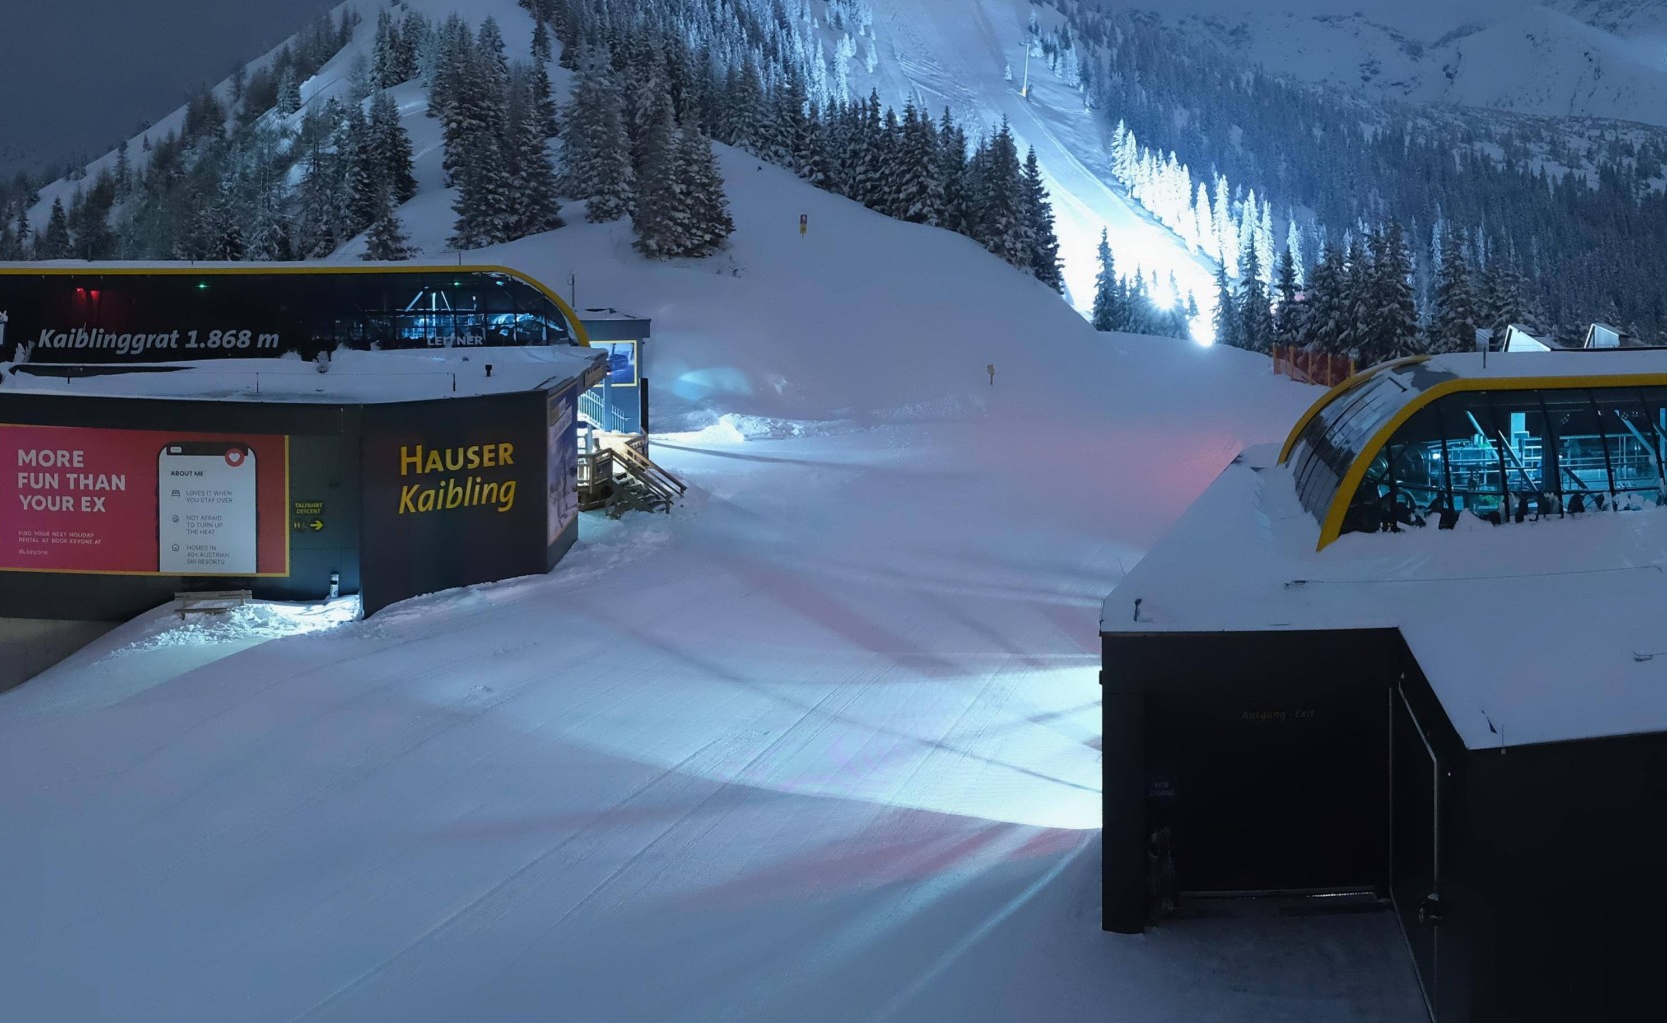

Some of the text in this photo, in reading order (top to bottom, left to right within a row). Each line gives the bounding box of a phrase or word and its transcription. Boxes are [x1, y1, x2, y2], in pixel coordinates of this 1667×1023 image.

[38, 328, 280, 355] Kaiblinggrat 1.868 m
[17, 449, 85, 468] MORE
[400, 442, 515, 476] HAUSER
[17, 472, 126, 491] FUN THAN
[18, 494, 106, 512] YOUR EX
[398, 476, 517, 514] Kaibling
[1295, 707, 1316, 719] Exit
